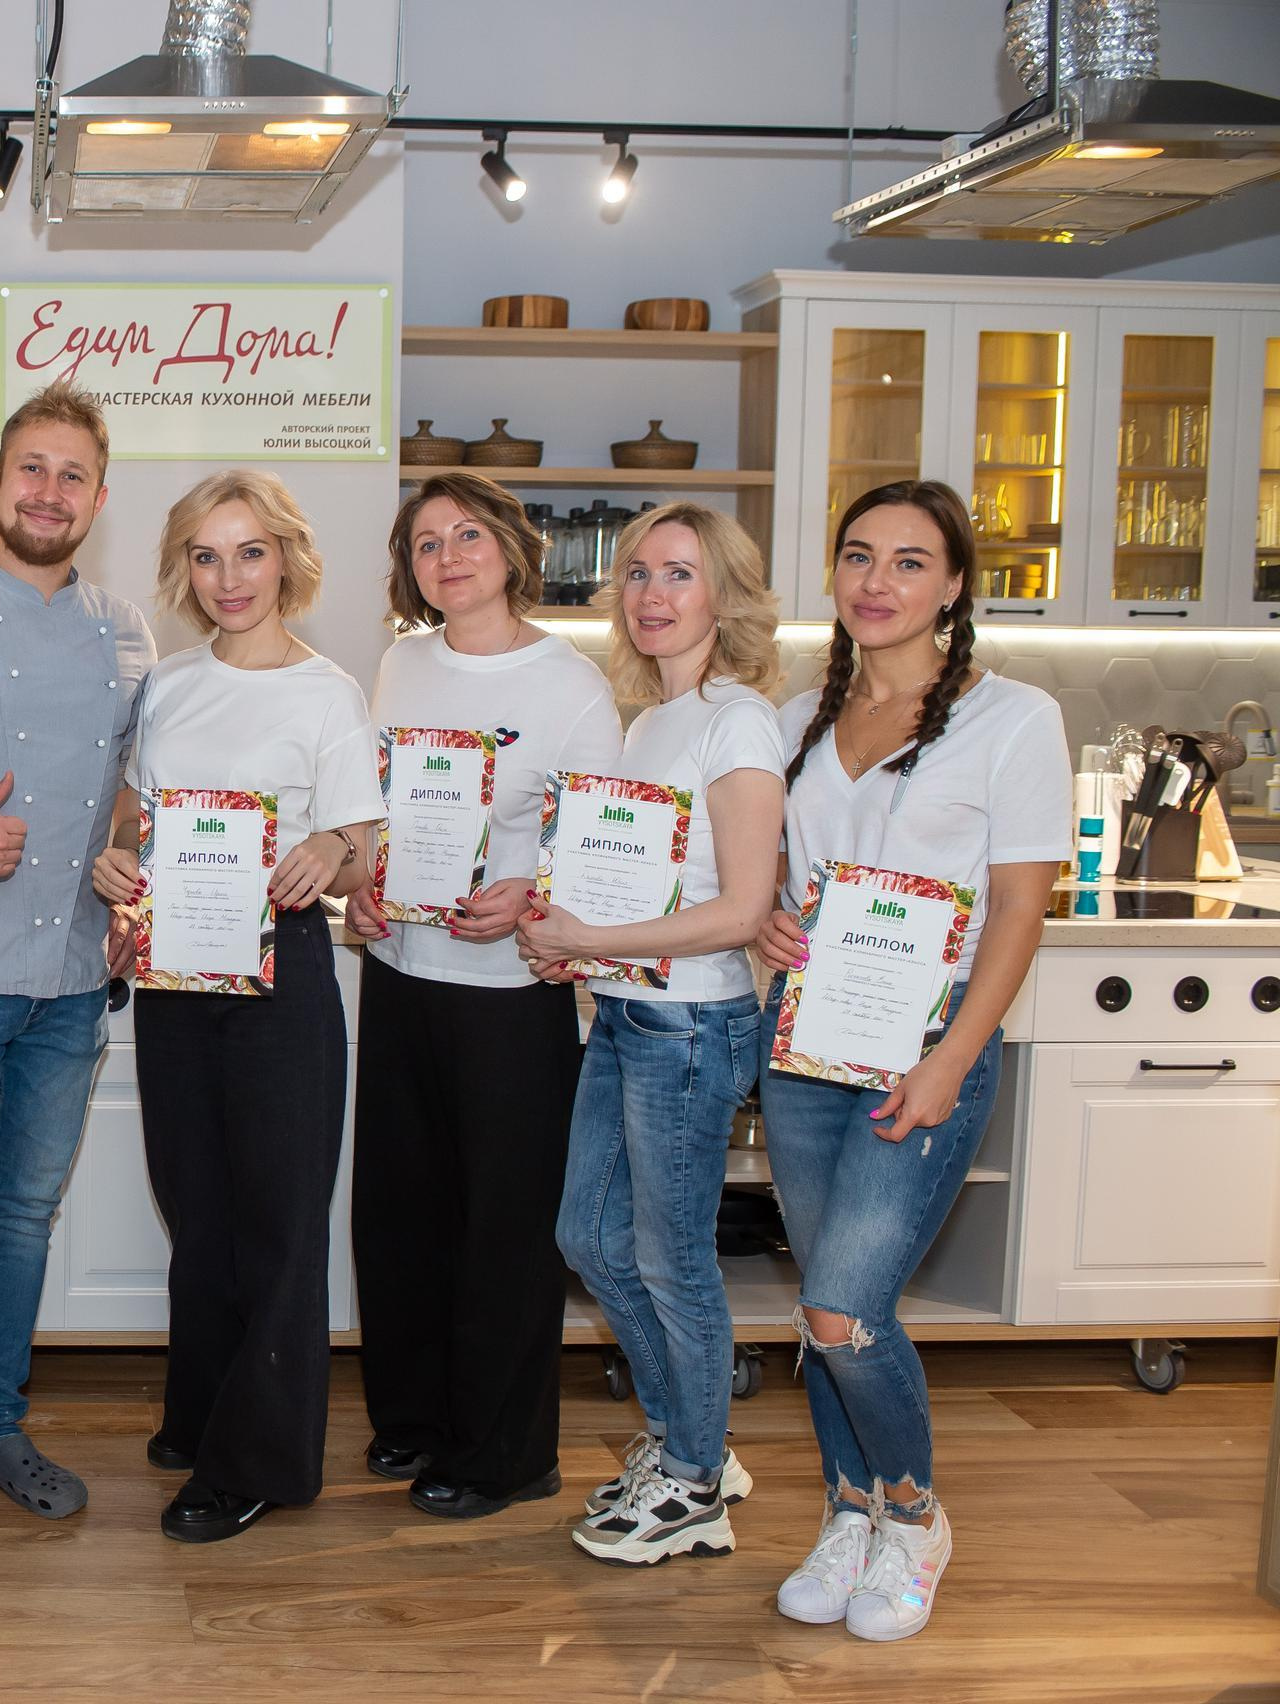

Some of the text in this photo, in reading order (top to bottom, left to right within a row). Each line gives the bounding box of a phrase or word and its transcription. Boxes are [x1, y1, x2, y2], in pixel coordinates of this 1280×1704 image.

[152, 301, 349, 385] Дома!
[200, 389, 295, 406] КУХОННОЙ
[302, 392, 372, 407] МЕБЕЛИ
[281, 424, 371, 434] АВТОРСКИЙ ПРОЕКТ
[263, 436, 372, 450] ЮЛИИ ВЫСОЦКОЙ
[410, 788, 461, 801] ДИПЛОМ
[581, 837, 645, 856] ДИПЛОМ
[177, 852, 239, 865] ДИПЛОМ
[841, 932, 915, 955] ДИПЛОМ
